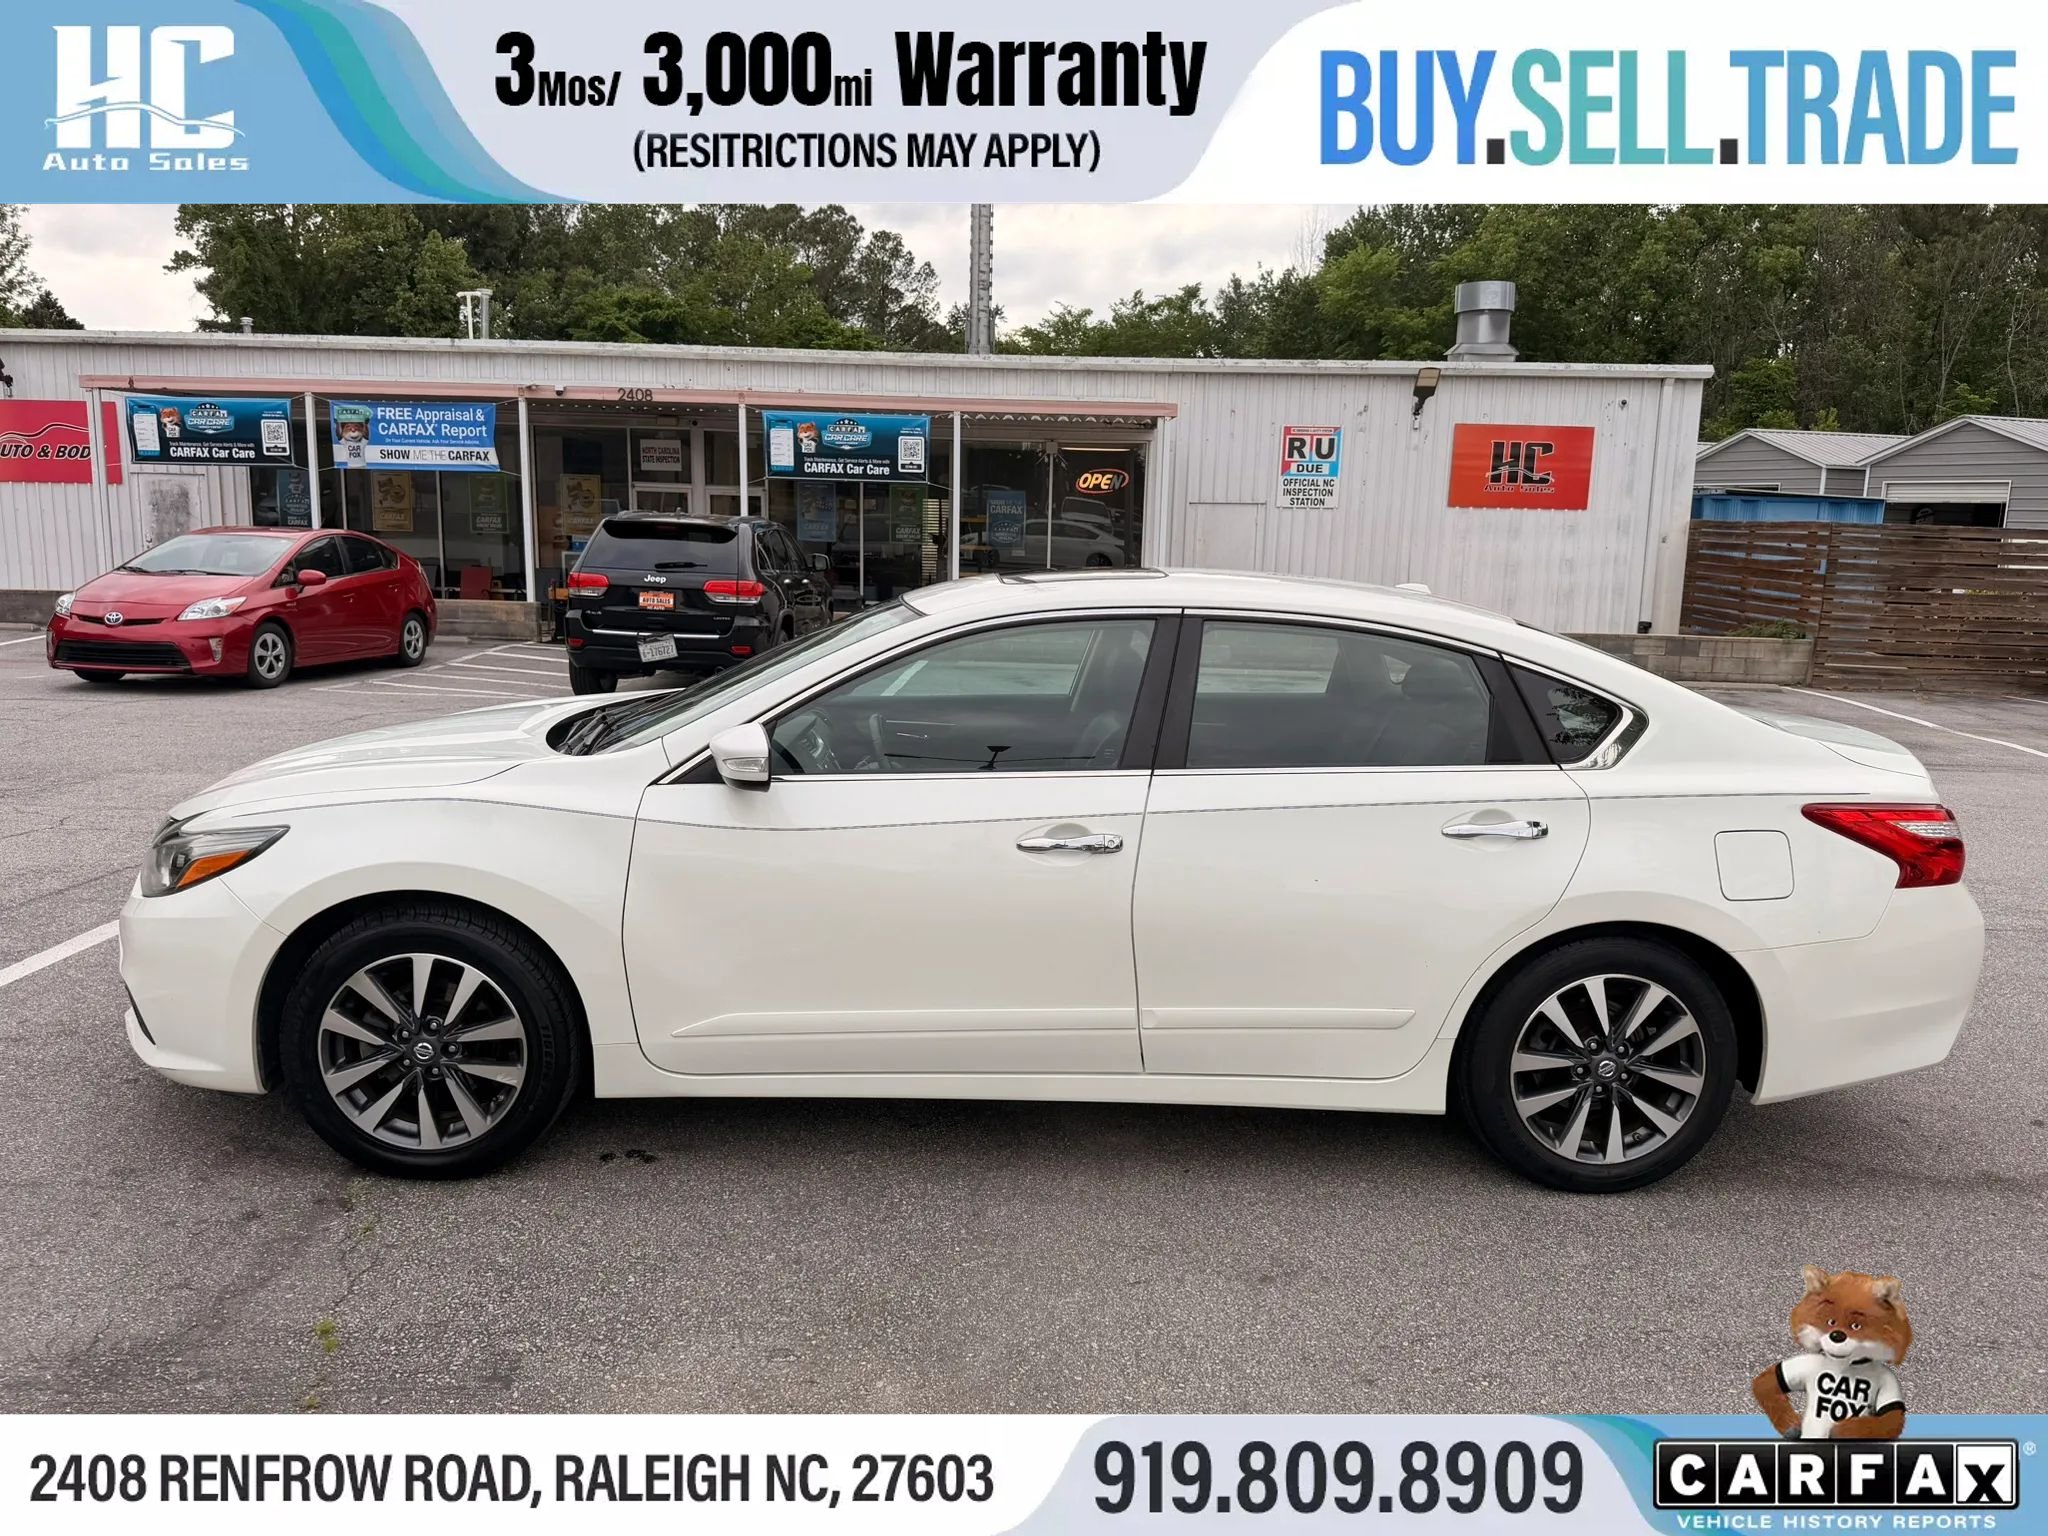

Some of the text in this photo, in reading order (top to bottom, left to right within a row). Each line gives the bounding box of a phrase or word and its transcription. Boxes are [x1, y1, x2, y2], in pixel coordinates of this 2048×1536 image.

[617, 387, 653, 401] 2408
[377, 407, 485, 423] FREE Appraisal &
[187, 418, 231, 426] CAR CARE
[378, 422, 488, 439] CARFAX Report
[829, 426, 865, 434] CARFAX
[843, 434, 868, 442] CARE
[36, 444, 52, 459] &
[170, 447, 256, 459] CARFAX Car Care
[379, 449, 490, 462] SHOW ME THE CARFAX
[642, 447, 680, 455] NORTH CAROLINA
[642, 455, 680, 464] STATE INSPECTION
[1489, 440, 1555, 485] HC
[804, 462, 890, 475] CARFAX Car Care
[1296, 464, 1323, 473] DUE
[1078, 473, 1123, 490] OPEN
[1282, 478, 1335, 487] OFFICIAL NC
[1282, 488, 1334, 497] INSPECTION
[1289, 498, 1326, 506] STATION
[990, 505, 1023, 514] CARFAX
[643, 574, 667, 584] Jeep
